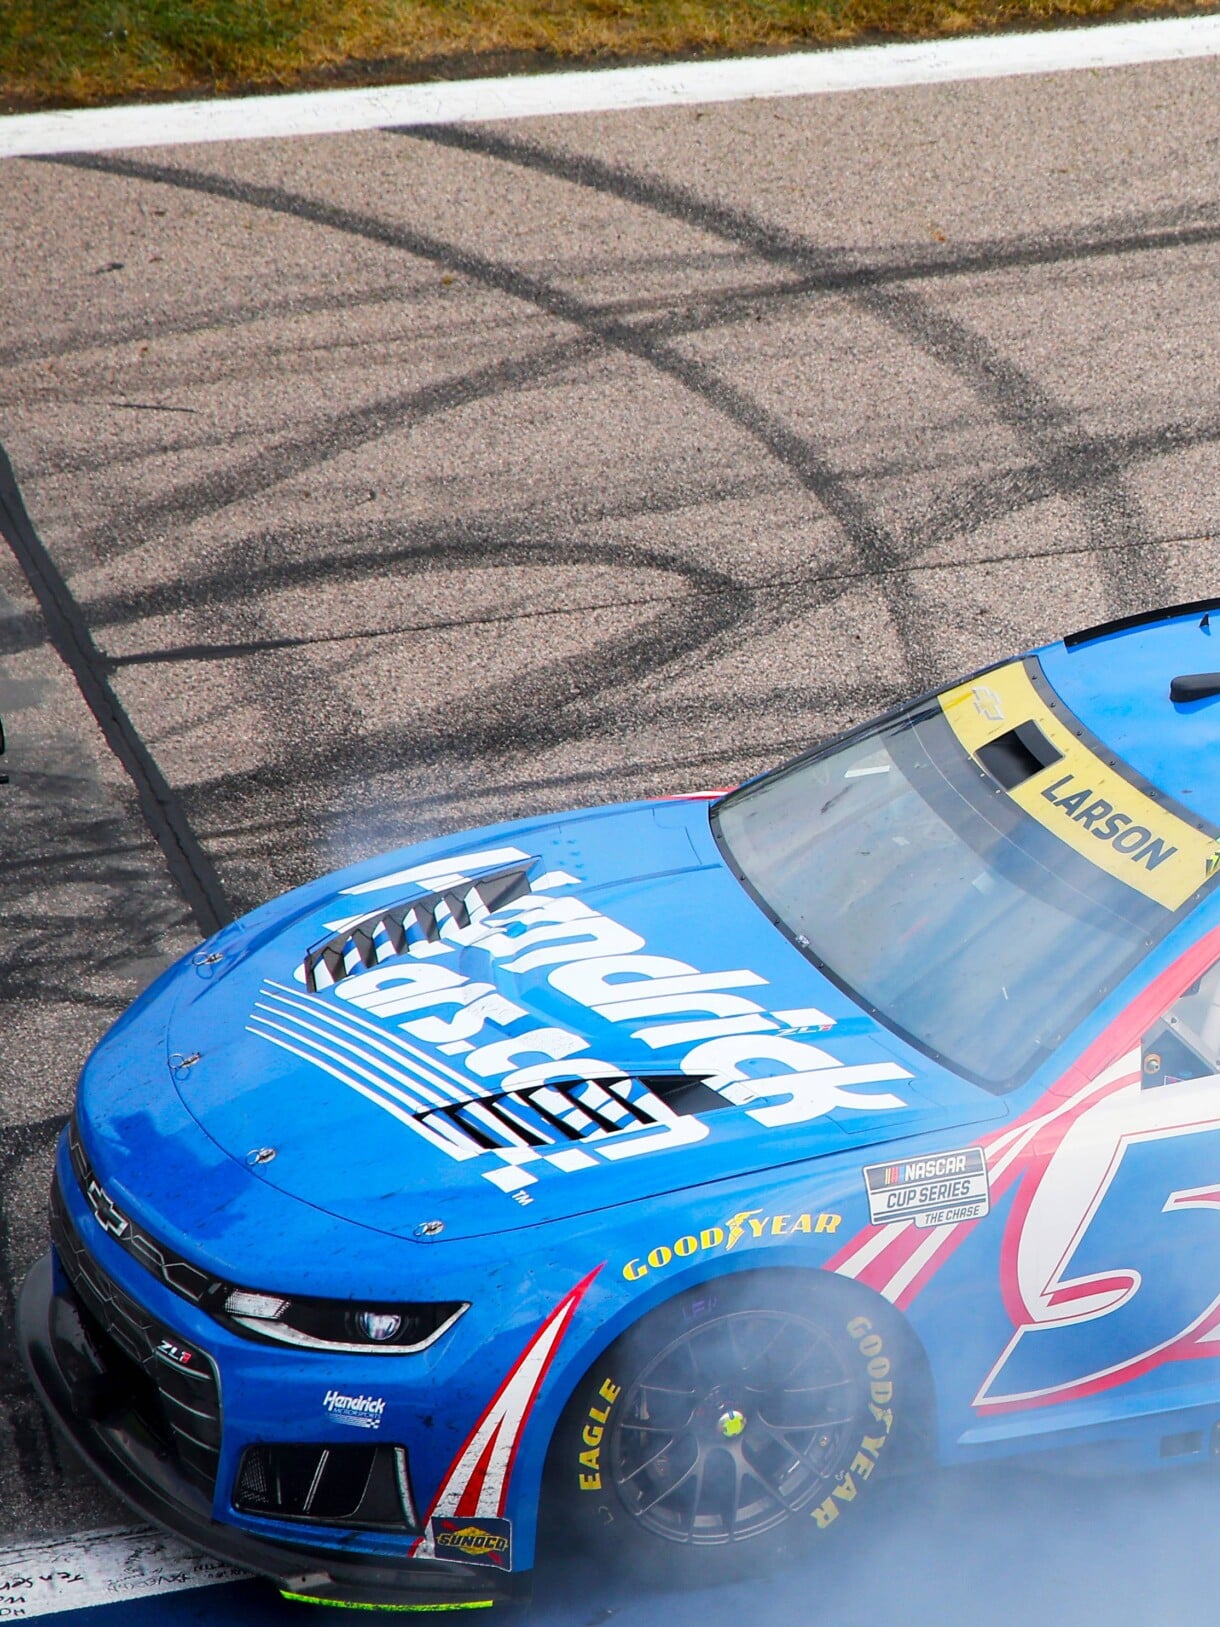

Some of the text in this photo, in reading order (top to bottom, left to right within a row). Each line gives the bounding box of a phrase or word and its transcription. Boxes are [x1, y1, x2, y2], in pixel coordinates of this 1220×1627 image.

[1040, 773, 1178, 872] LARSON
[904, 1155, 967, 1184] NASCAR
[886, 1179, 971, 1210] CUP SERIES
[924, 1204, 981, 1225] THE CHASE
[622, 1212, 842, 1282] GOODYEAR
[155, 1339, 192, 1364] ZL1
[322, 1390, 386, 1415] Hendrick
[578, 1377, 622, 1492] EAGLE
[811, 1315, 894, 1530] GOODYEAR
[436, 1532, 508, 1552] SUNOCO
